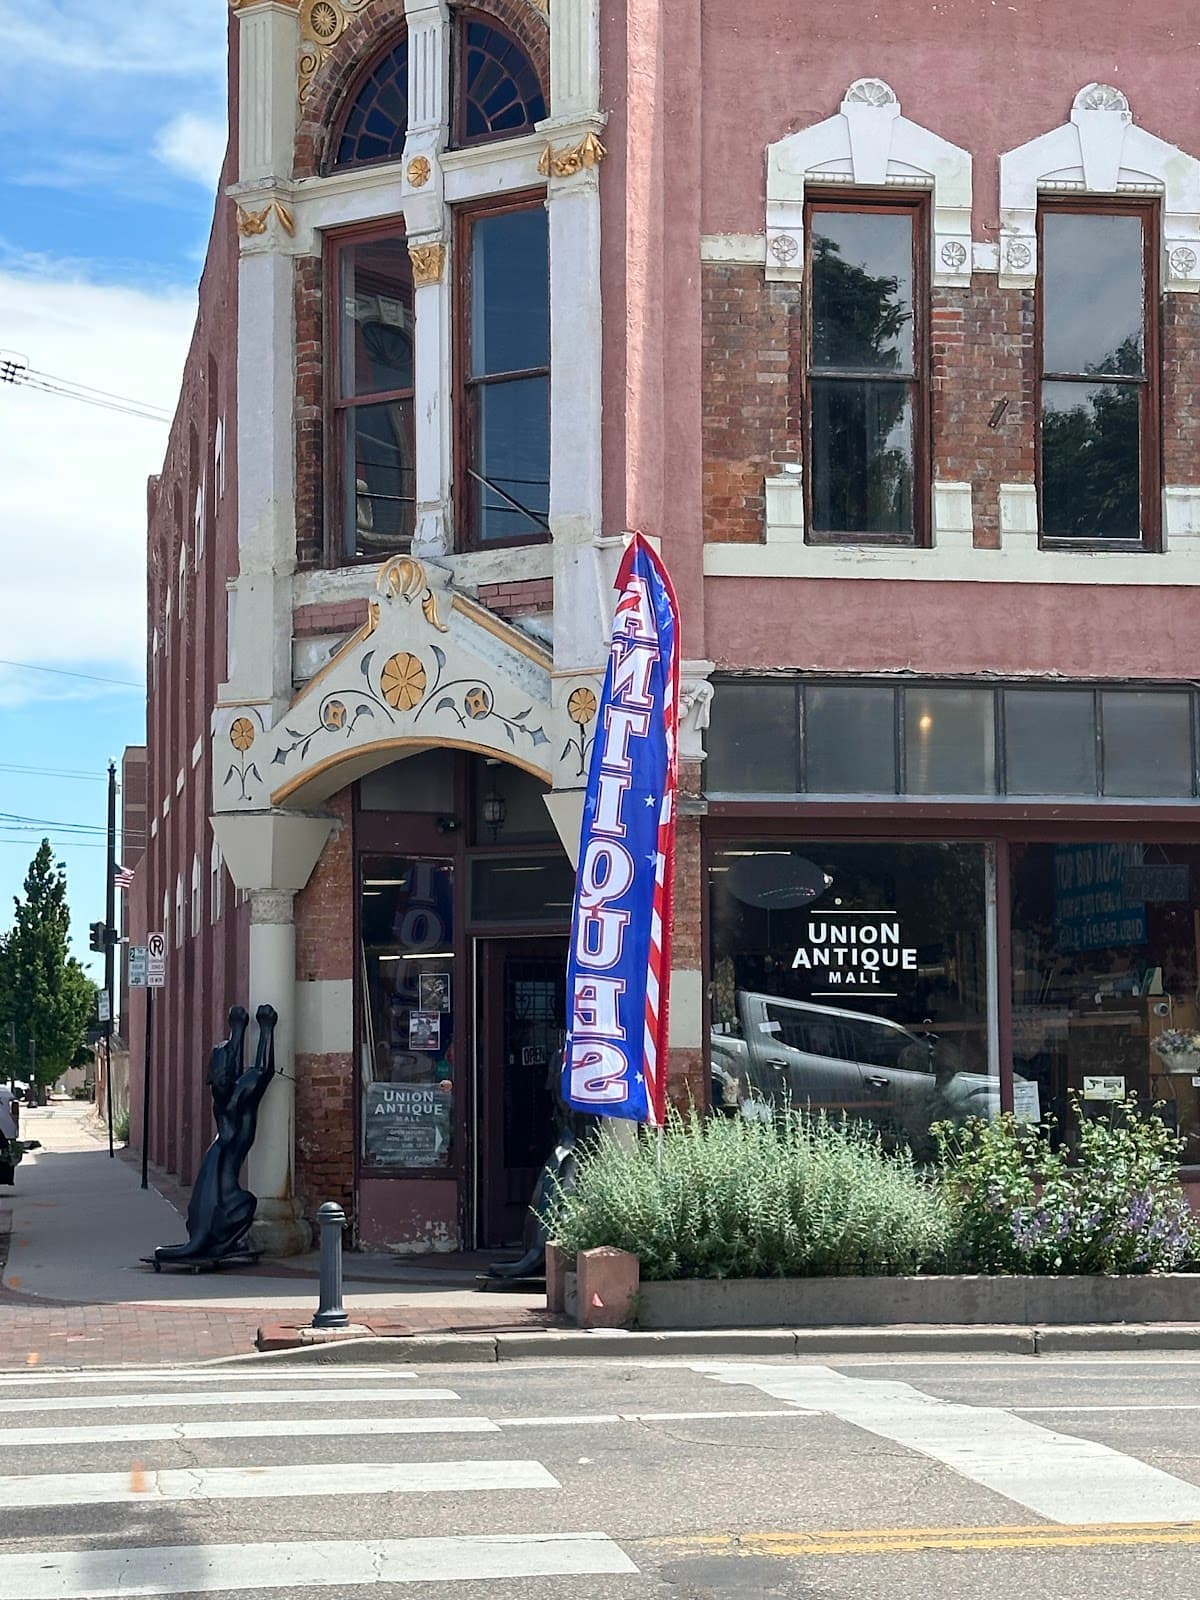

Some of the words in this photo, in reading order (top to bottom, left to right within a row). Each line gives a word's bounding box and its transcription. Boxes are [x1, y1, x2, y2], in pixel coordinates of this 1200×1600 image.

[807, 922, 900, 945] UNION
[791, 947, 918, 971] ANTIQUE
[828, 971, 881, 984] MALL
[523, 1046, 545, 1064] OPEN
[383, 1090, 434, 1102] UNION
[374, 1104, 444, 1116] ANTIQUE
